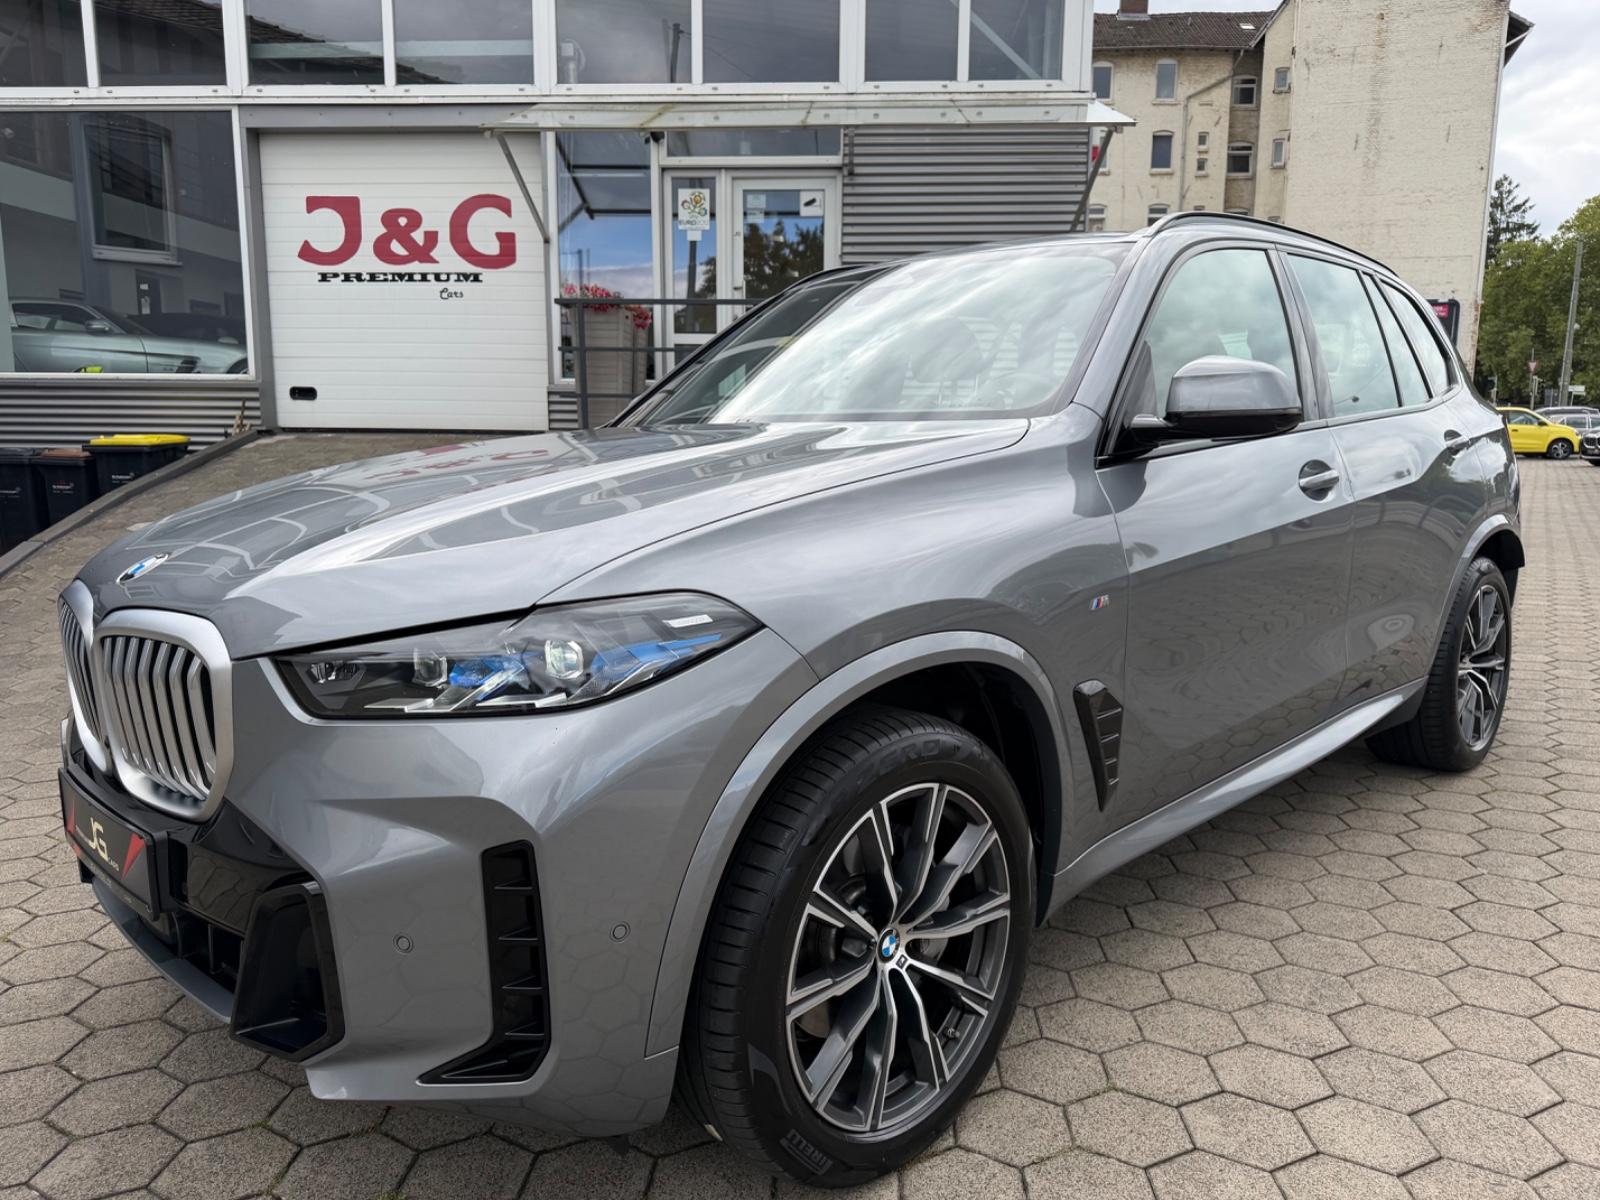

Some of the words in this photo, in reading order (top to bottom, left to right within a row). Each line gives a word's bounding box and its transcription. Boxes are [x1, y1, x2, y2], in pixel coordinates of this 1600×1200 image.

[297, 193, 517, 269] J&G
[317, 272, 483, 283] PREMIUM
[439, 287, 464, 300] Cars
